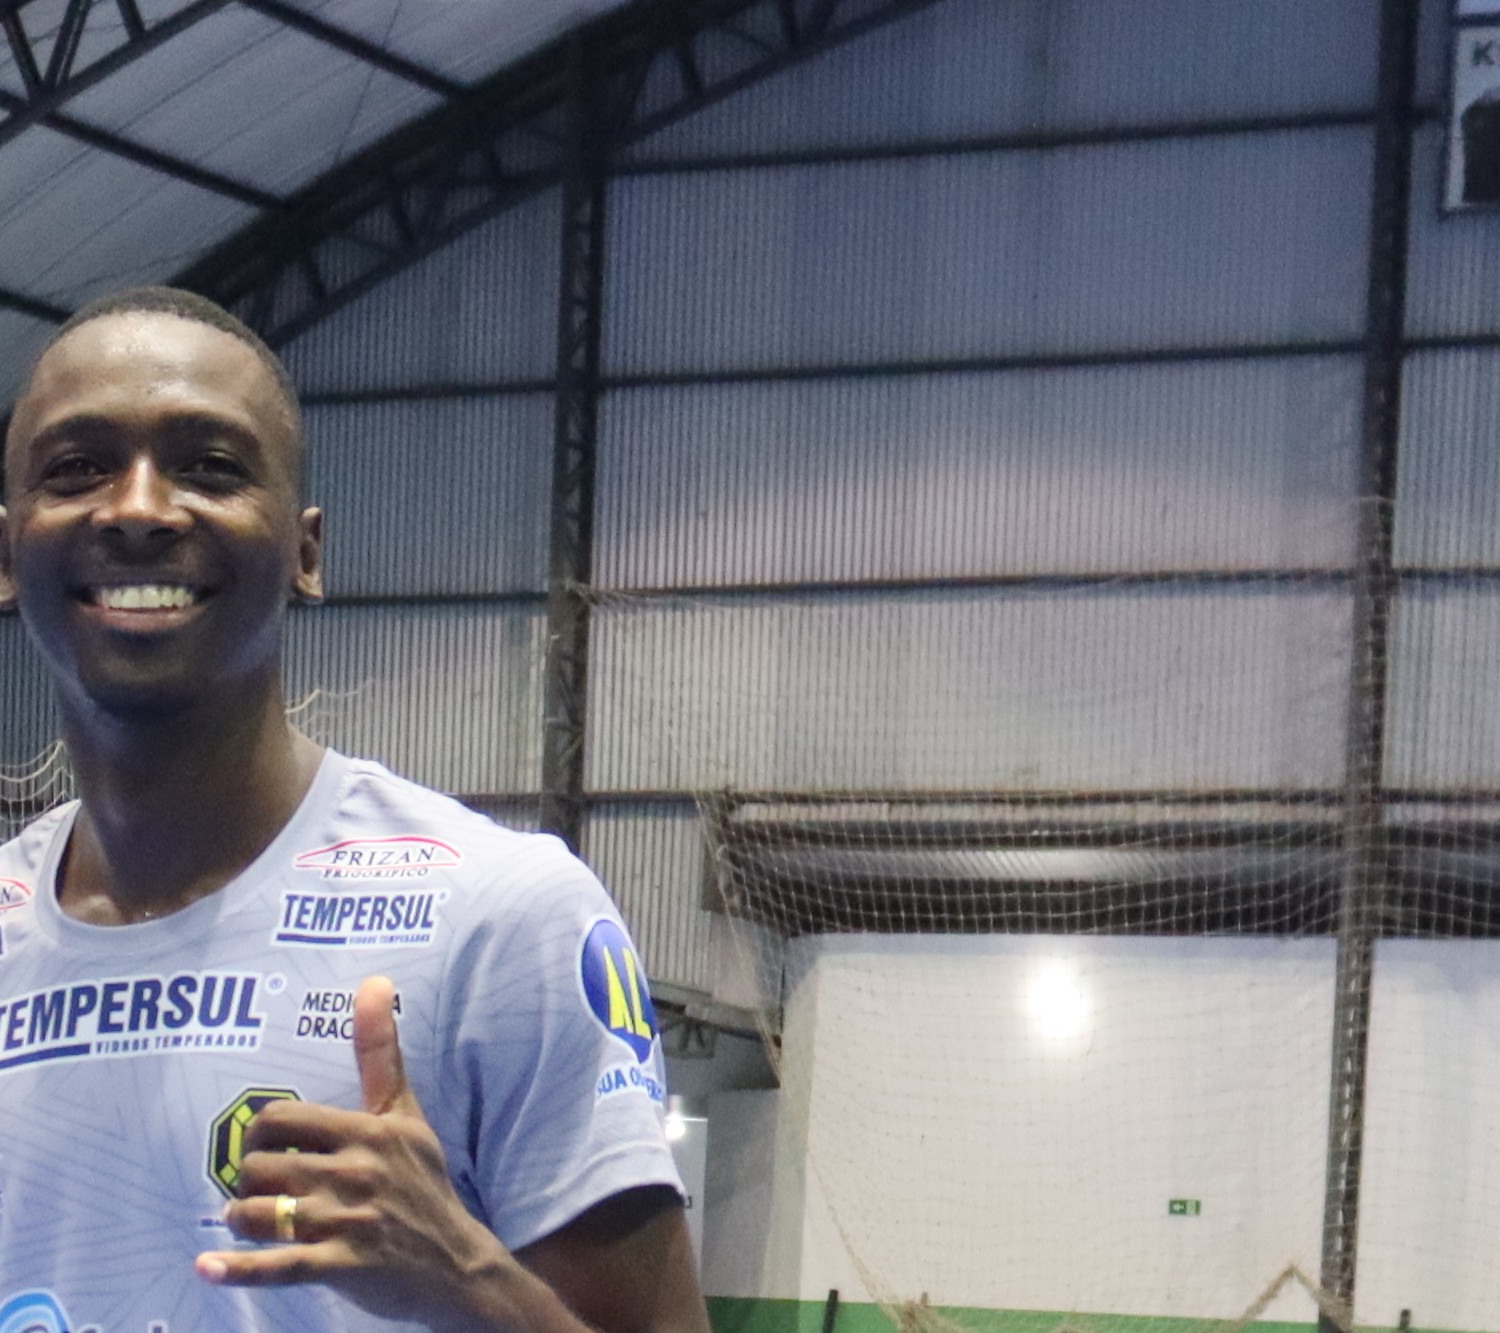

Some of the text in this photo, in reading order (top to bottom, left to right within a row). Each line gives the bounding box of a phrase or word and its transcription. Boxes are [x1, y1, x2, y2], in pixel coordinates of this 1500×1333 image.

[331, 848, 436, 866] FRIZAN
[283, 894, 434, 932] TEMPERSUL
[302, 992, 401, 1014] MEDIA
[297, 1016, 354, 1039] DRAC
